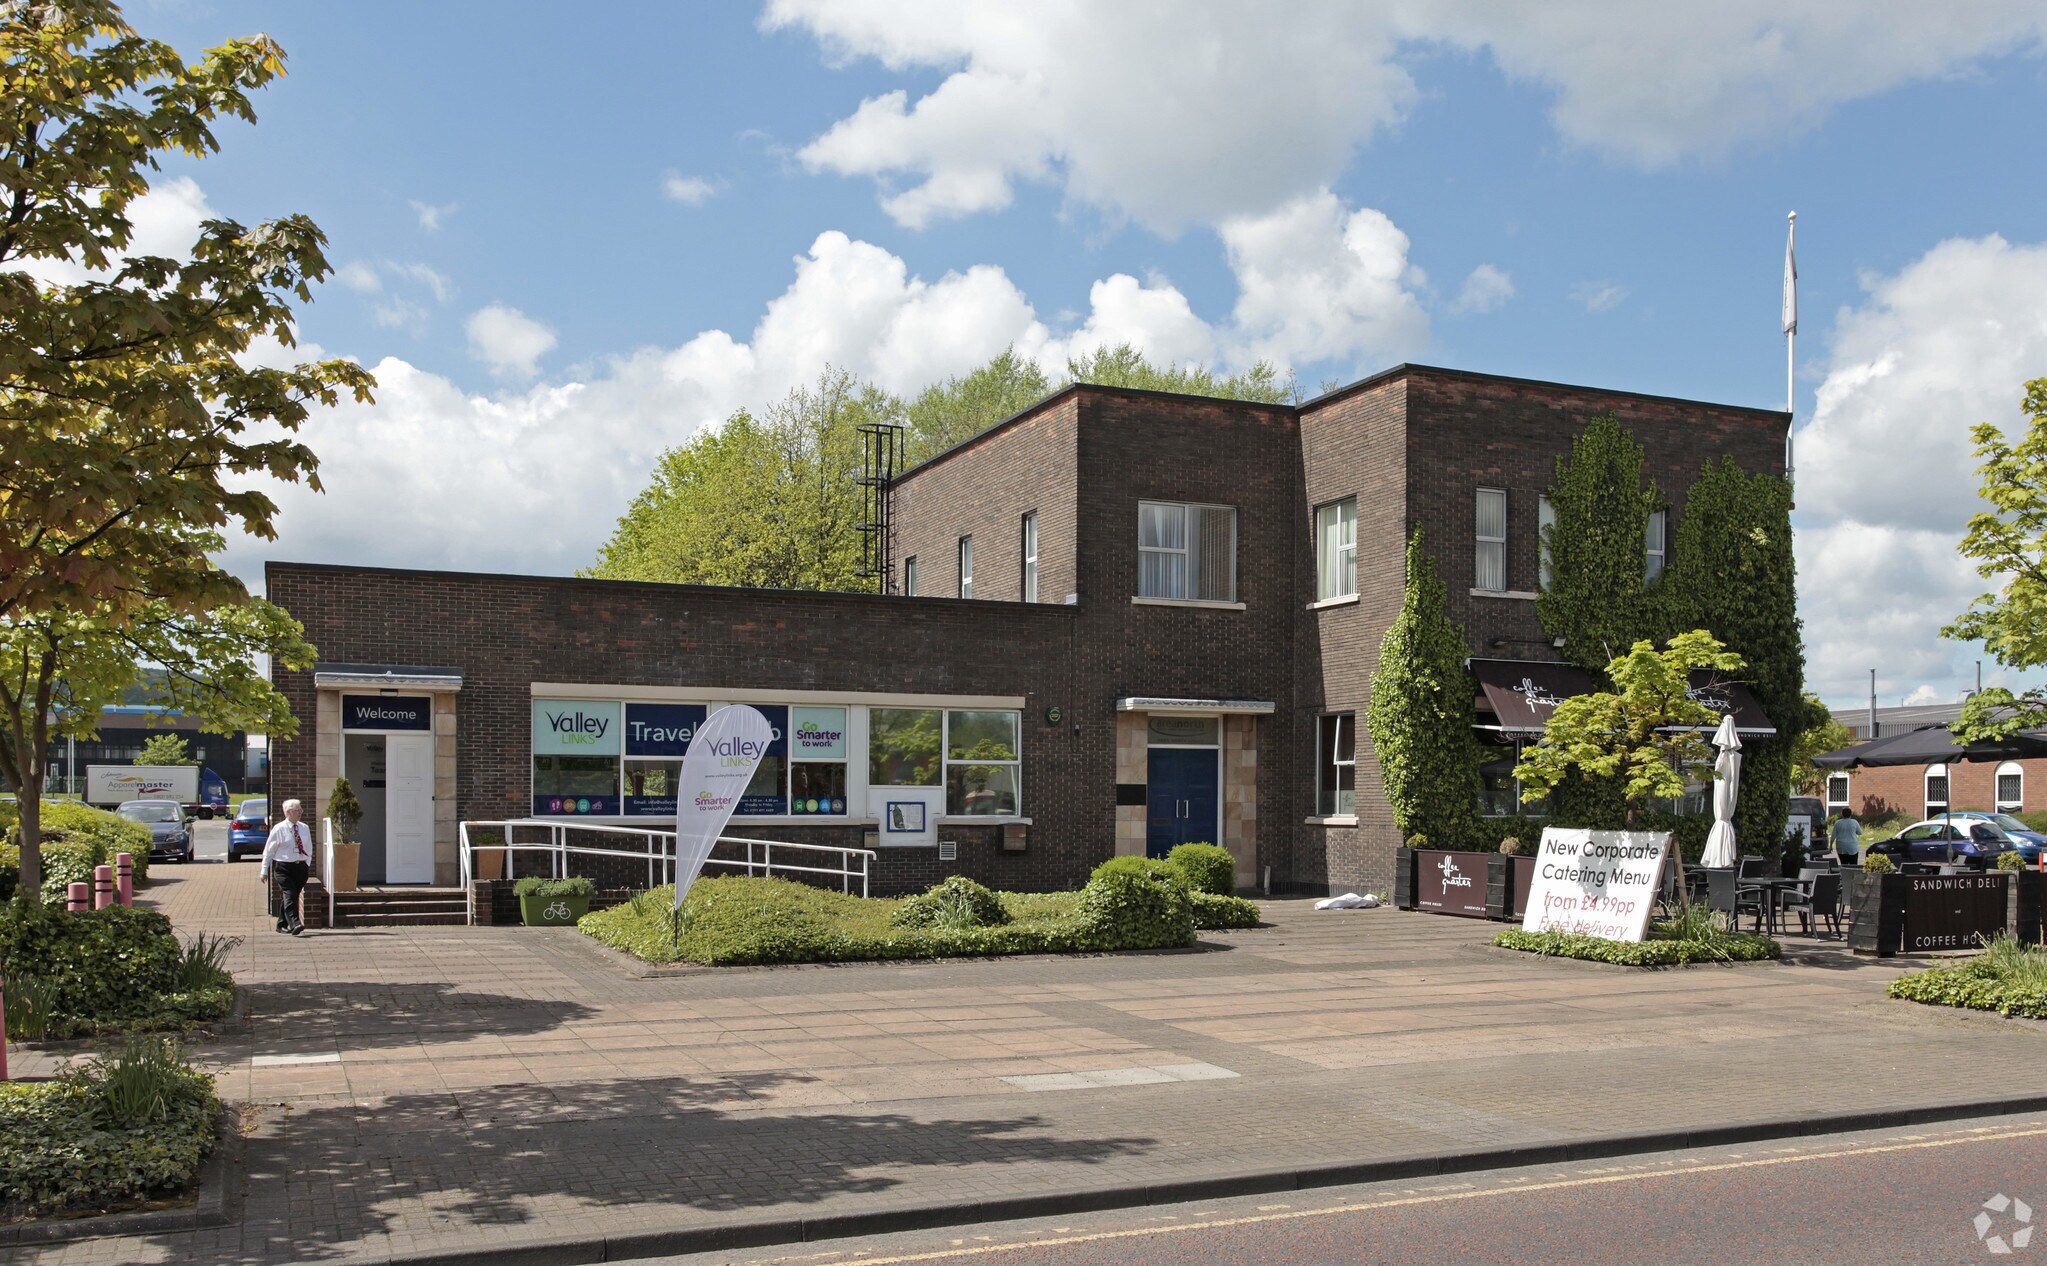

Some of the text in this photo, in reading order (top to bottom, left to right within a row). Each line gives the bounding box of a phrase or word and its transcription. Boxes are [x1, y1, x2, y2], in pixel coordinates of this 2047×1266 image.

[1512, 677, 1548, 698] coffee
[356, 707, 417, 720] Welcome
[545, 711, 609, 738] Valley
[630, 721, 697, 742] Travel
[796, 730, 842, 740] Smarter
[802, 721, 818, 731] Go
[561, 734, 597, 745] LINKS
[704, 736, 765, 760] Valley
[720, 757, 752, 767] LINKS
[695, 797, 732, 805] Smarter
[1545, 839, 1659, 861] New Corporate
[1437, 855, 1459, 877] coffee
[1542, 863, 1651, 887] Catering Menu
[1442, 873, 1472, 895] quarter
[1913, 878, 2000, 890] SANDWICH DELI
[1543, 890, 1635, 916] from £4.99pp
[1915, 935, 1957, 947] COFFEE
